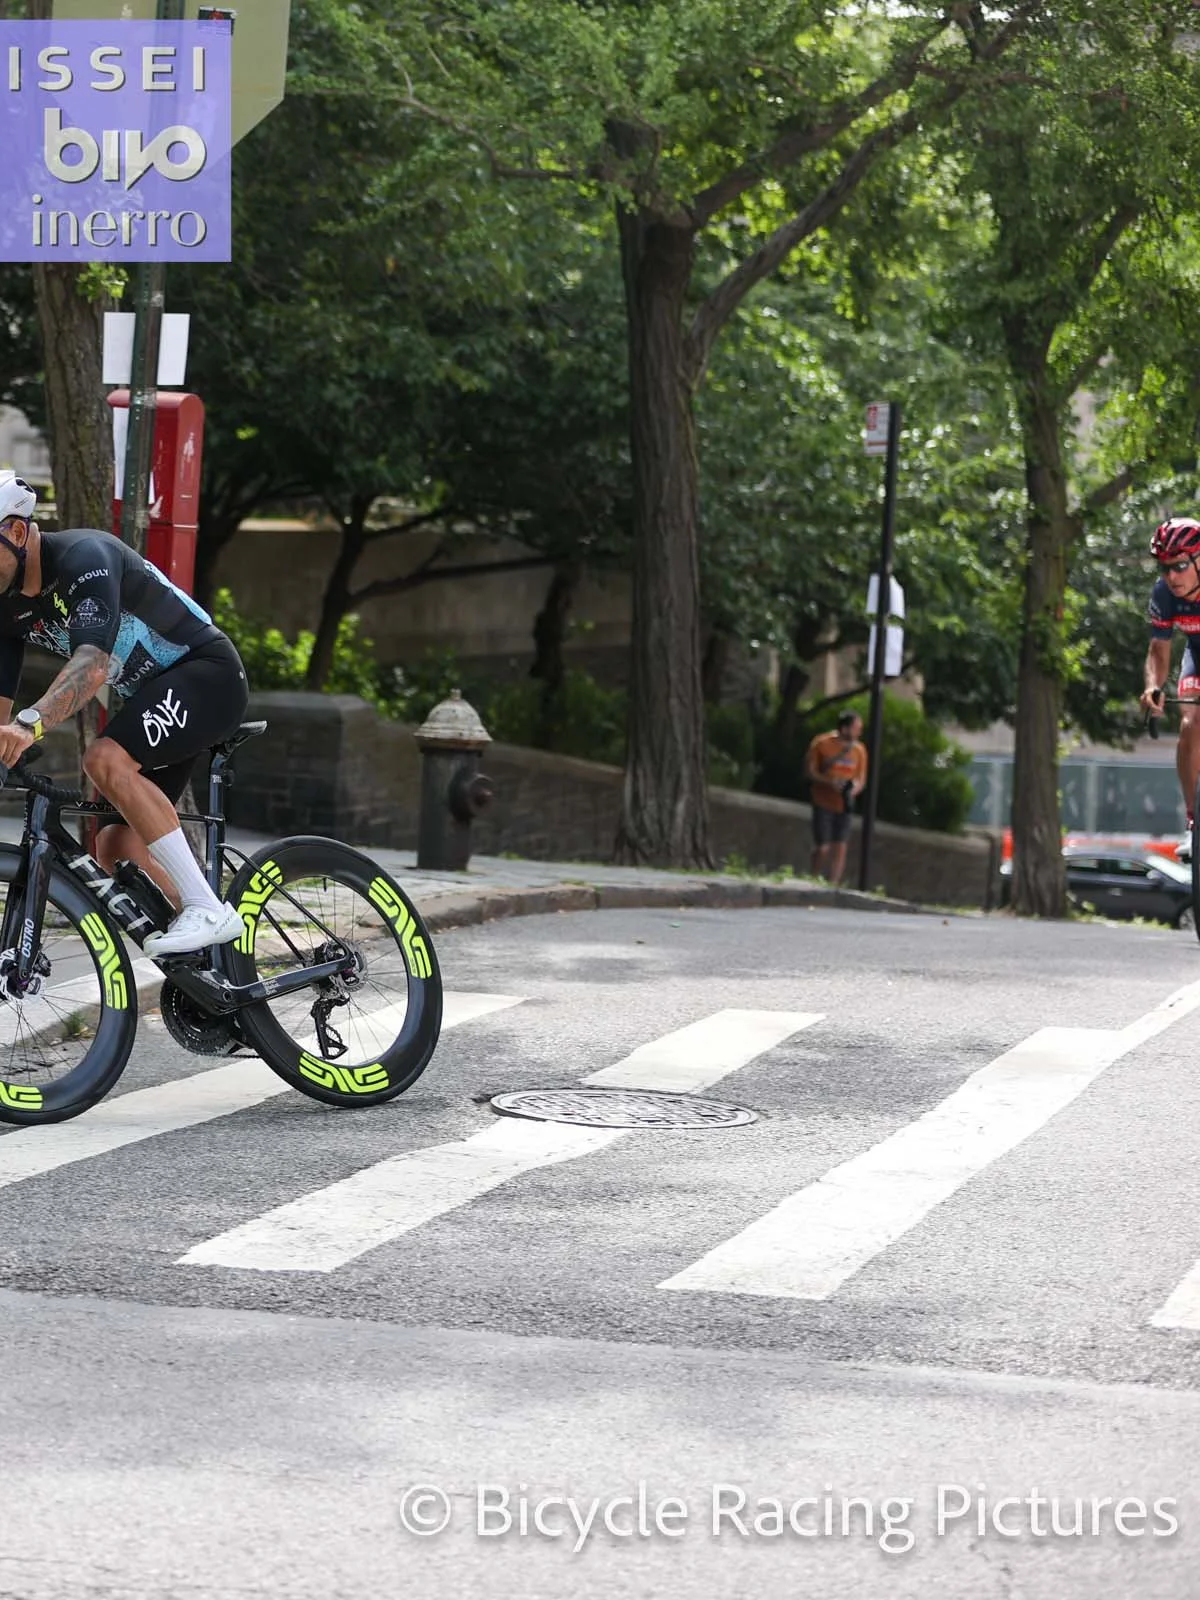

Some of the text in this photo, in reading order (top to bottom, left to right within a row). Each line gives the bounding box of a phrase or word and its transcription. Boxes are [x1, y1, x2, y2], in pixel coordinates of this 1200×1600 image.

[77, 568, 110, 584] SOULY
[141, 709, 153, 720] BE
[143, 688, 188, 748] ONE
[21, 917, 35, 959] OSTRO
